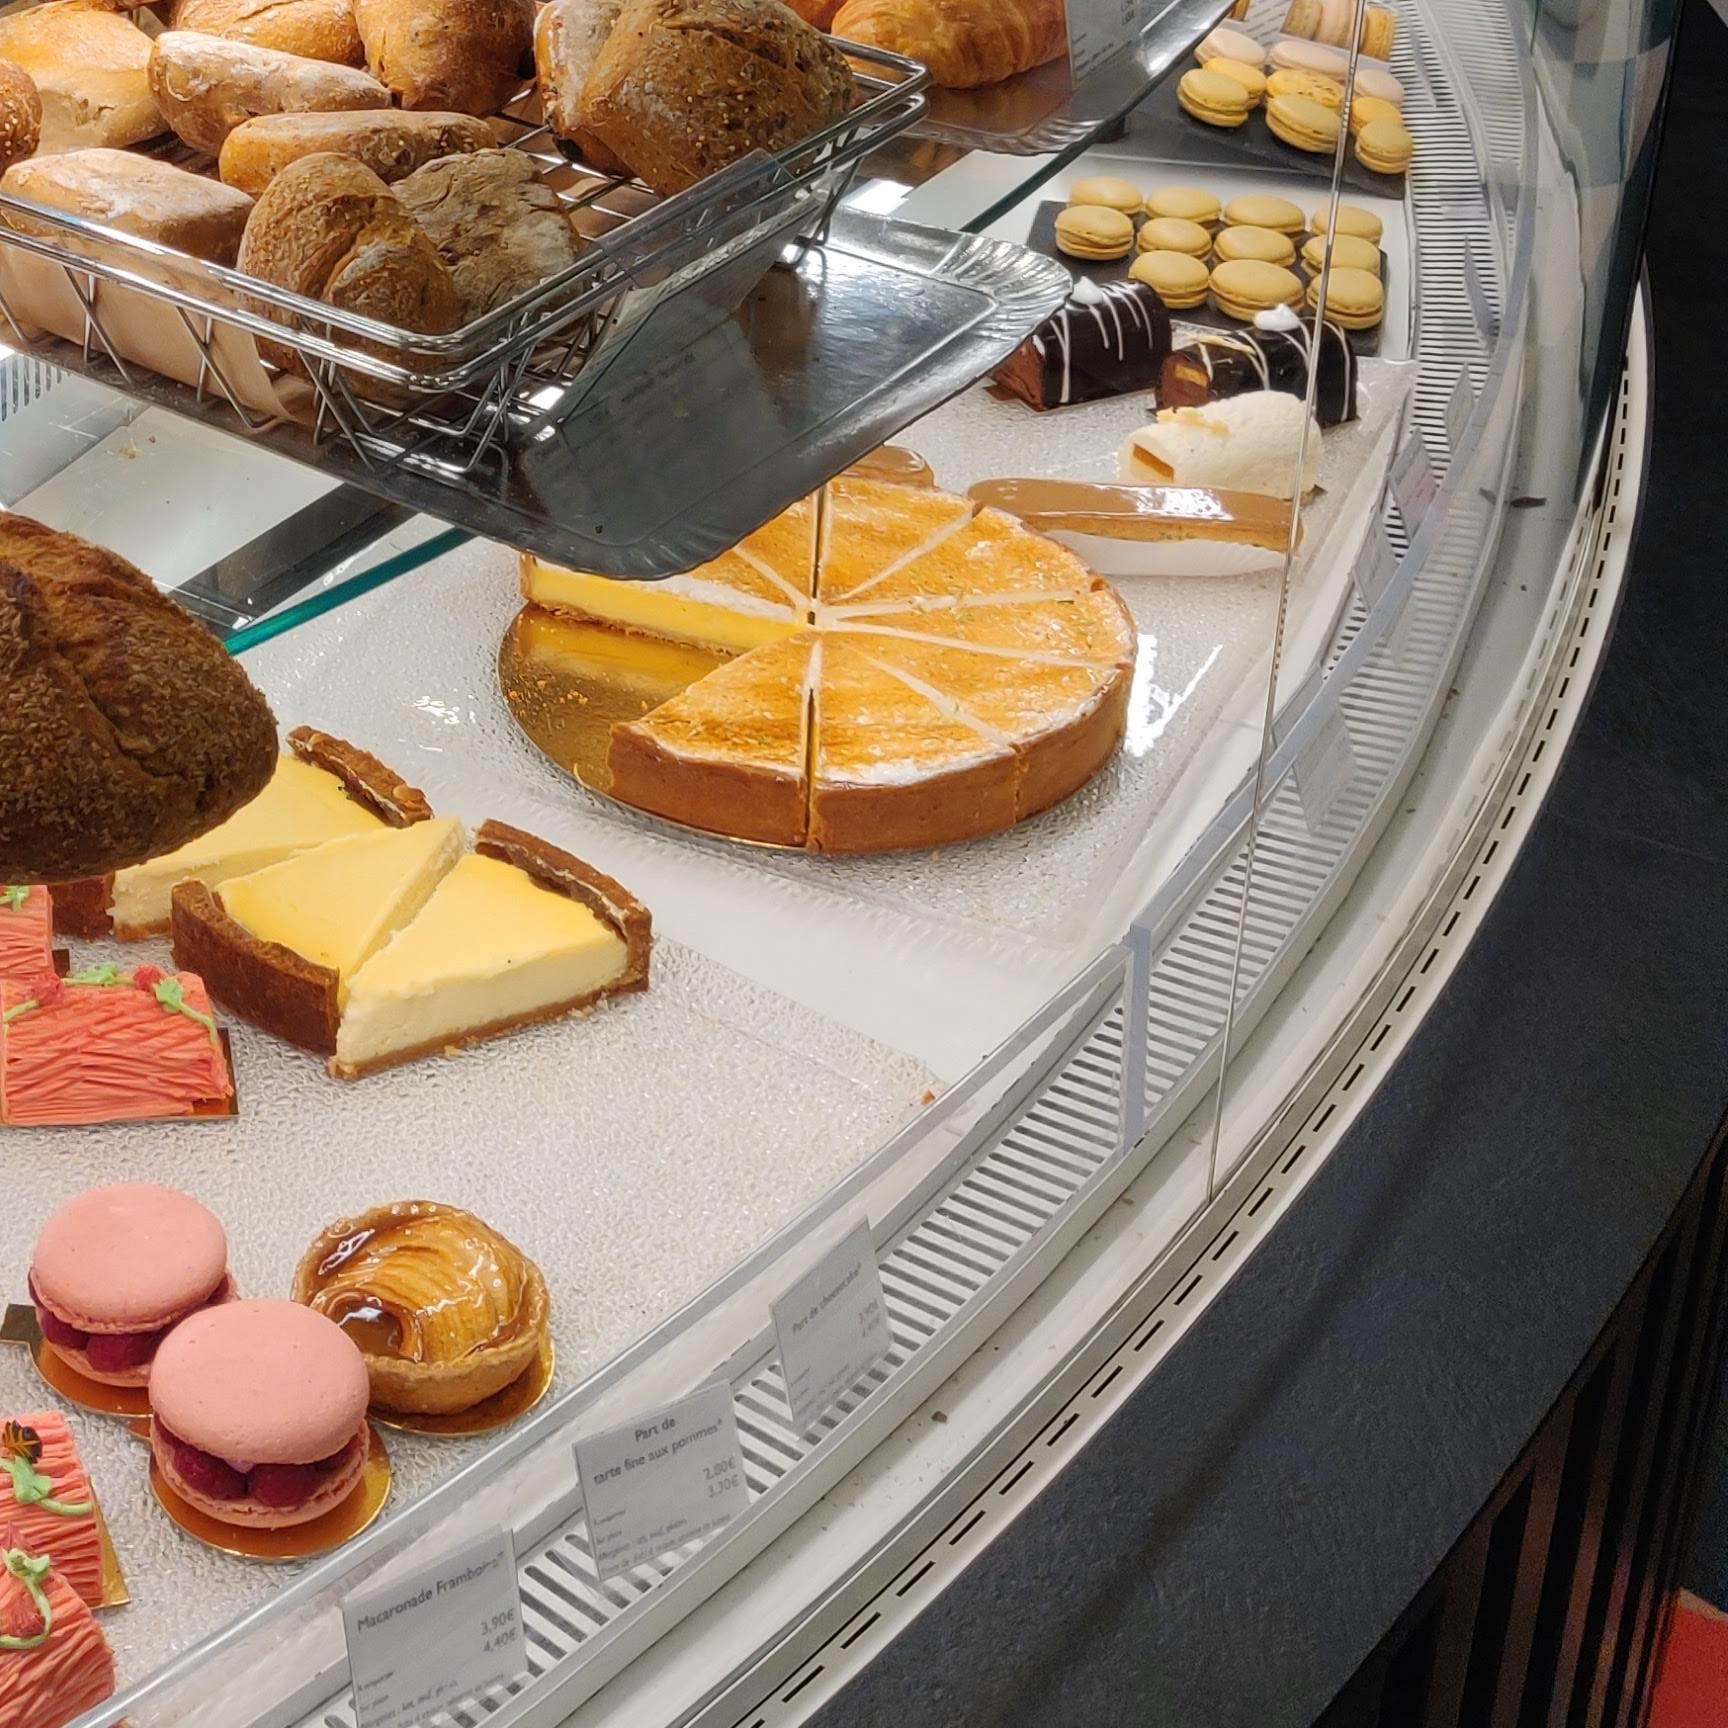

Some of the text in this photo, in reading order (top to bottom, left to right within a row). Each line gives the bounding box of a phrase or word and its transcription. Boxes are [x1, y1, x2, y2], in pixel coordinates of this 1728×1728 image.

[634, 1417, 677, 1443] Part de
[624, 1454, 647, 1472] fine
[648, 1446, 669, 1462] aux
[357, 1587, 434, 1633] Macaronade
